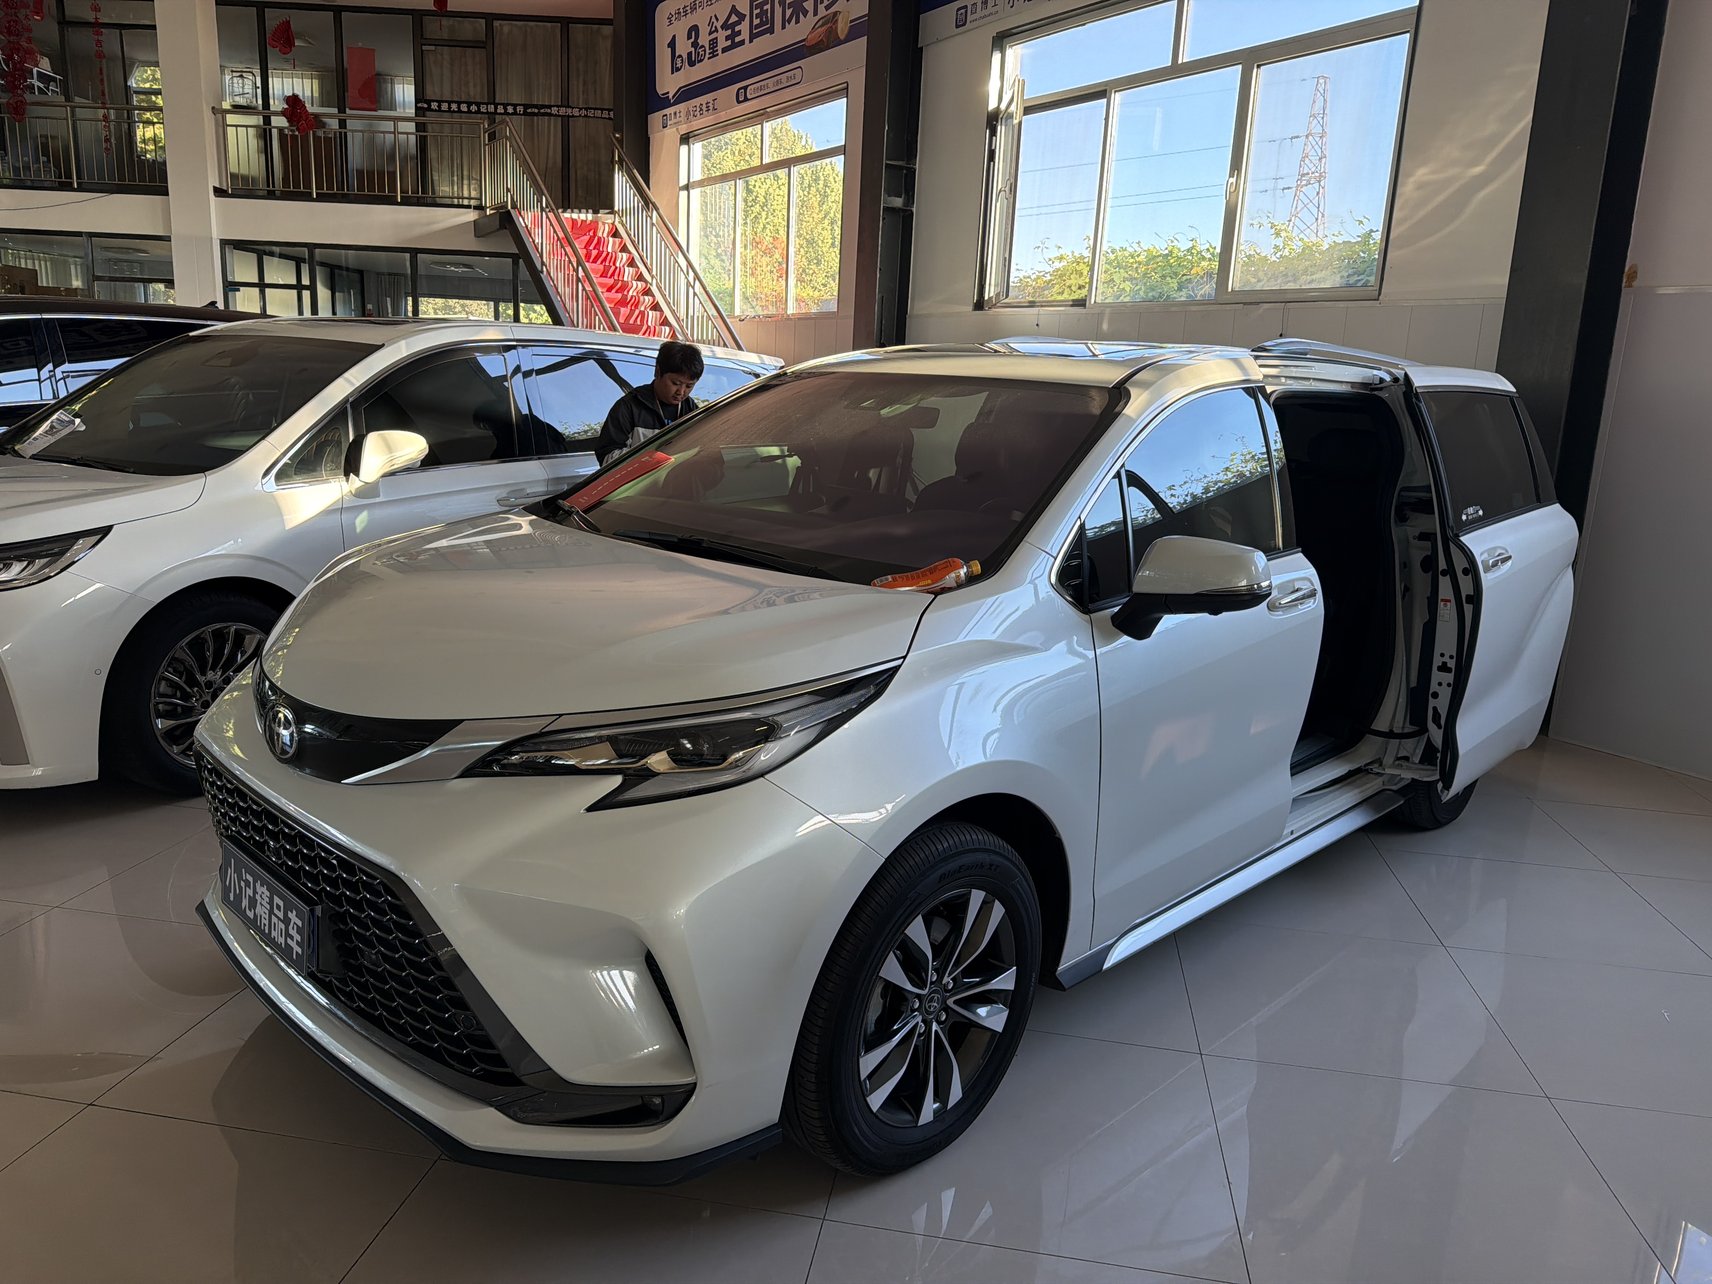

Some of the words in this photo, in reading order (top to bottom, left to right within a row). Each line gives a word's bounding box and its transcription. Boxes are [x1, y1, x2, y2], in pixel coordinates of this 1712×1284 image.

[226, 858, 302, 960] 小记精品车
